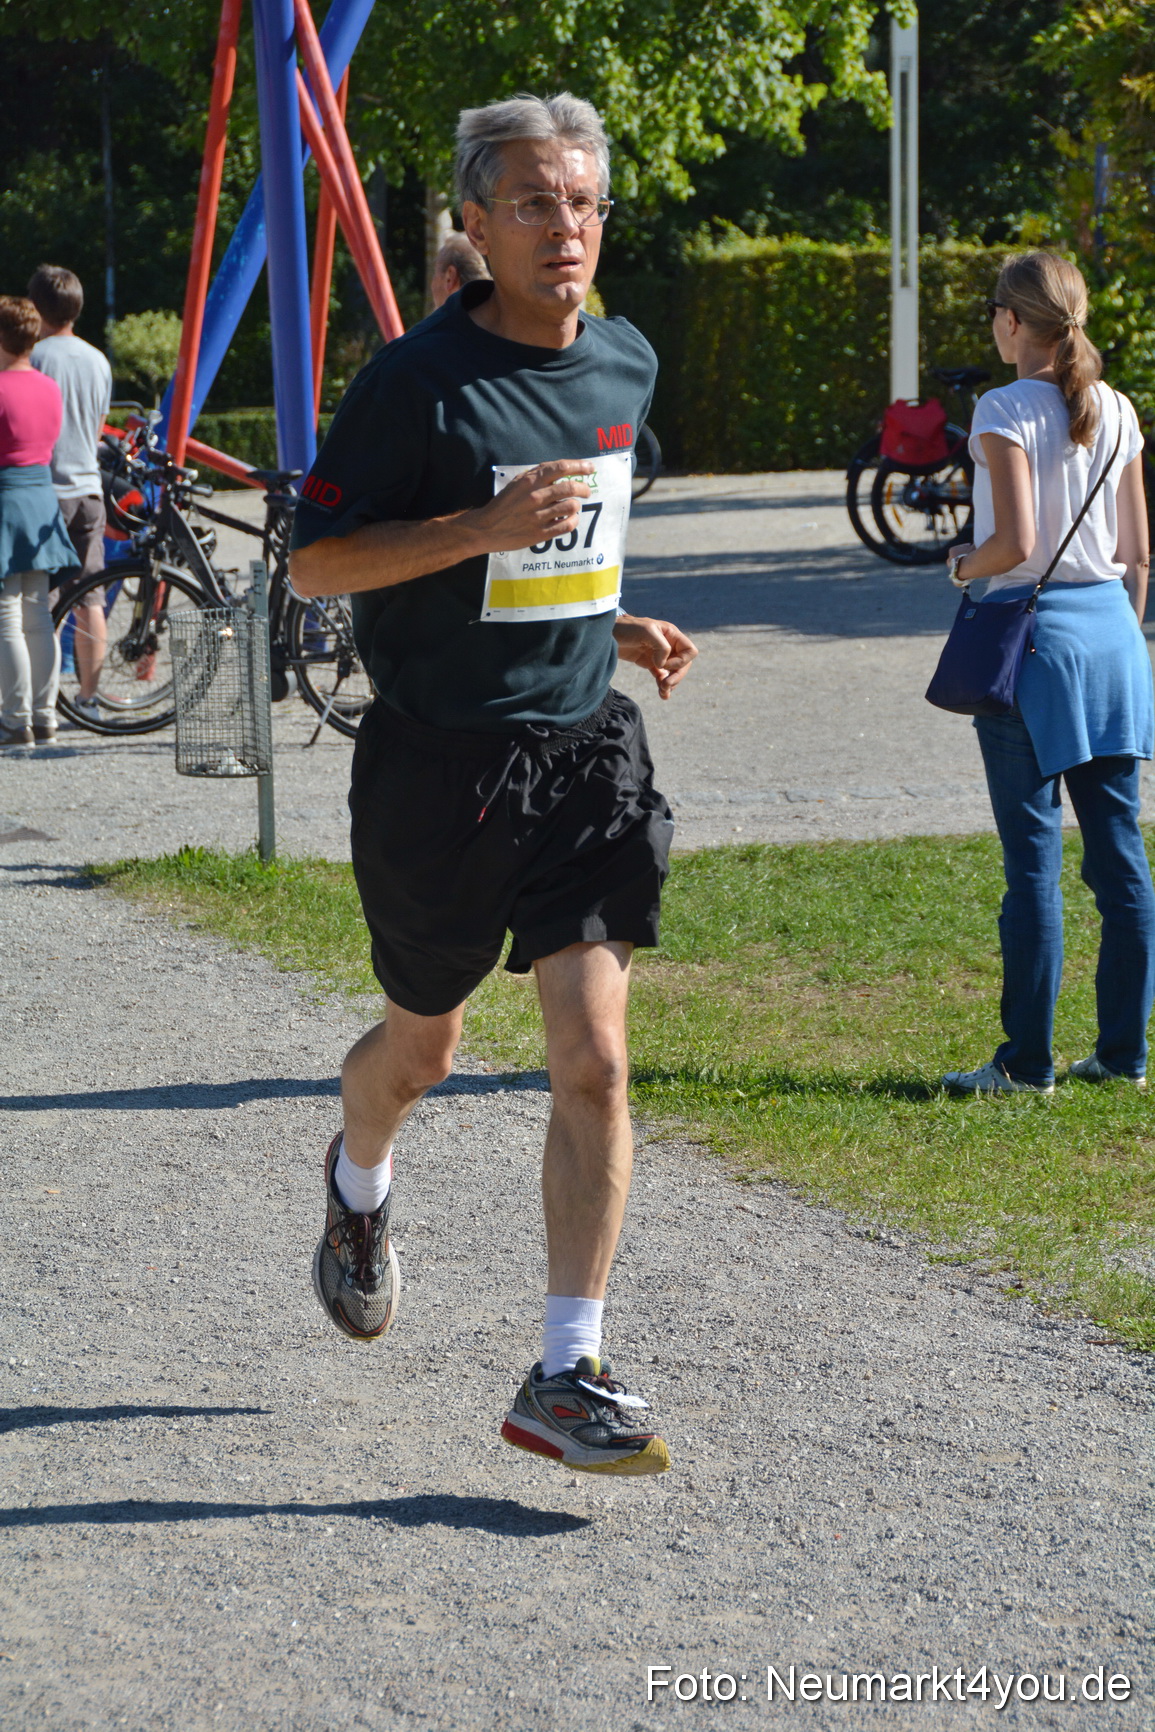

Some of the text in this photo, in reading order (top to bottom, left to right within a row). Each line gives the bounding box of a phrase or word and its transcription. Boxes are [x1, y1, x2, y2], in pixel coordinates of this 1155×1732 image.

[596, 423, 633, 450] MID
[522, 557, 594, 571] PARTL Neumarkt
